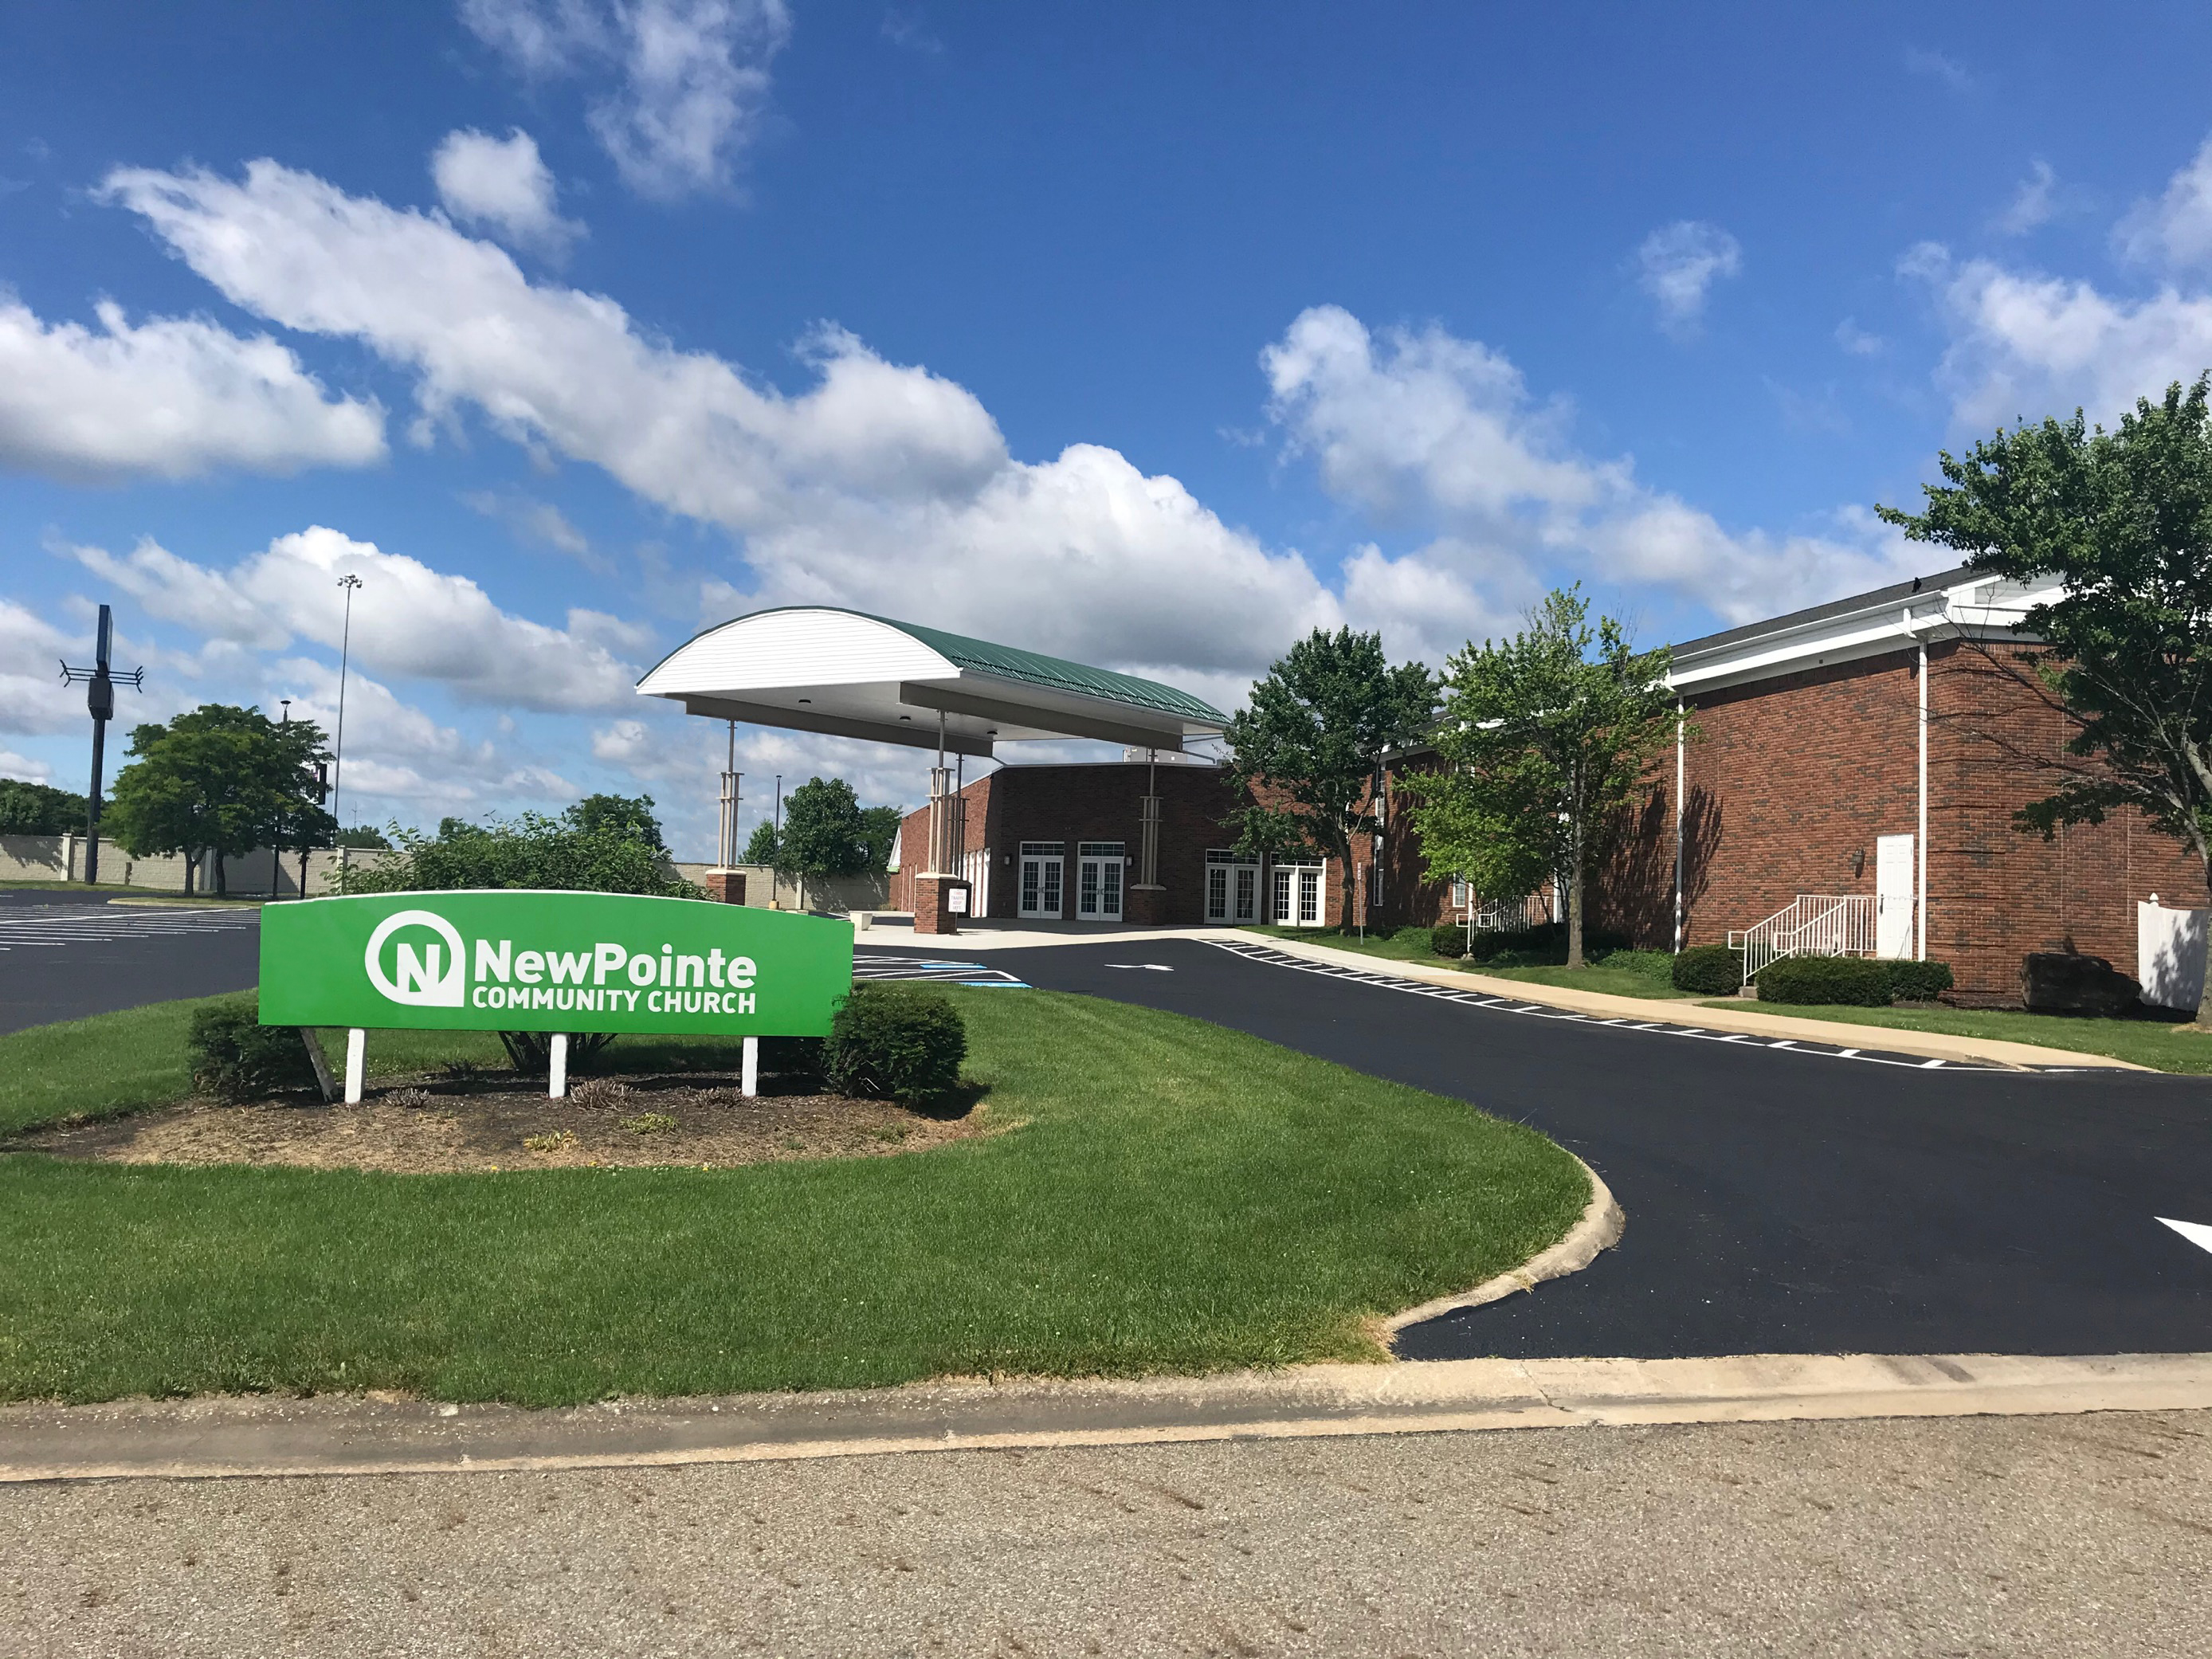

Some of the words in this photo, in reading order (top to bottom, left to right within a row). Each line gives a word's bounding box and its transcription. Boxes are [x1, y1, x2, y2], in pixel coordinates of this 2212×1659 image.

[474, 939, 757, 989] NewPointe
[473, 986, 641, 1012] COMMUNITY
[647, 990, 756, 1014] CHURCH
